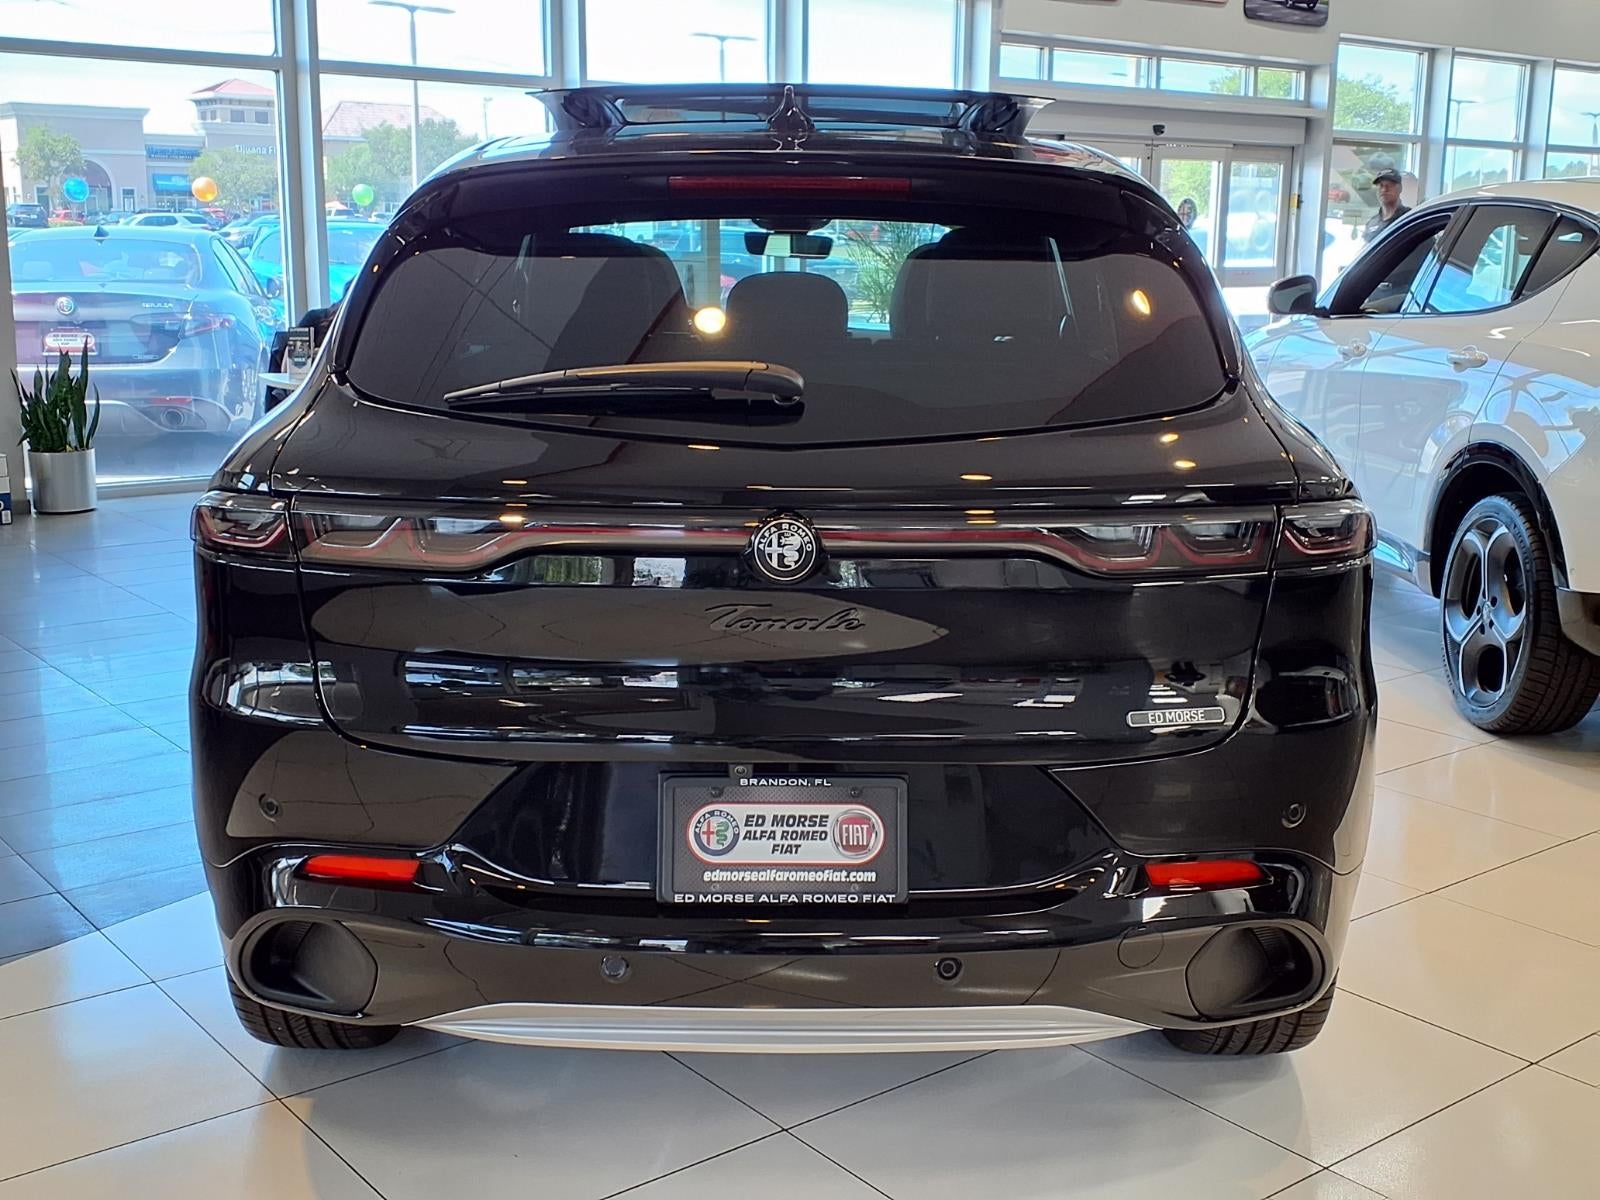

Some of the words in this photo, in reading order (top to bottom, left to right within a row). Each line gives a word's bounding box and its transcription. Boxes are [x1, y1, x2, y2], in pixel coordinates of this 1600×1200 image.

[758, 526, 778, 551] ALFA
[781, 523, 812, 552] ROMEO
[704, 603, 866, 632] Tonale
[1148, 712, 1163, 724] ED
[1166, 710, 1205, 723] MORSE
[739, 778, 811, 787] BRANDON,
[814, 778, 832, 787] FL
[694, 811, 711, 835] ALFA
[713, 810, 740, 835] ROMEO
[743, 814, 767, 828] ED
[771, 814, 830, 828] MORSE
[742, 830, 776, 841] ALFA
[779, 830, 828, 841] ROMEO
[842, 823, 870, 846] FIAT
[771, 843, 802, 855] FIAT
[703, 868, 877, 883] edmorsealfaromeofiat.com
[674, 894, 695, 904] ED
[699, 894, 755, 904] MORSE
[758, 894, 799, 904] ALFA
[802, 894, 859, 904] ROMEO
[862, 894, 896, 904] FIAT
